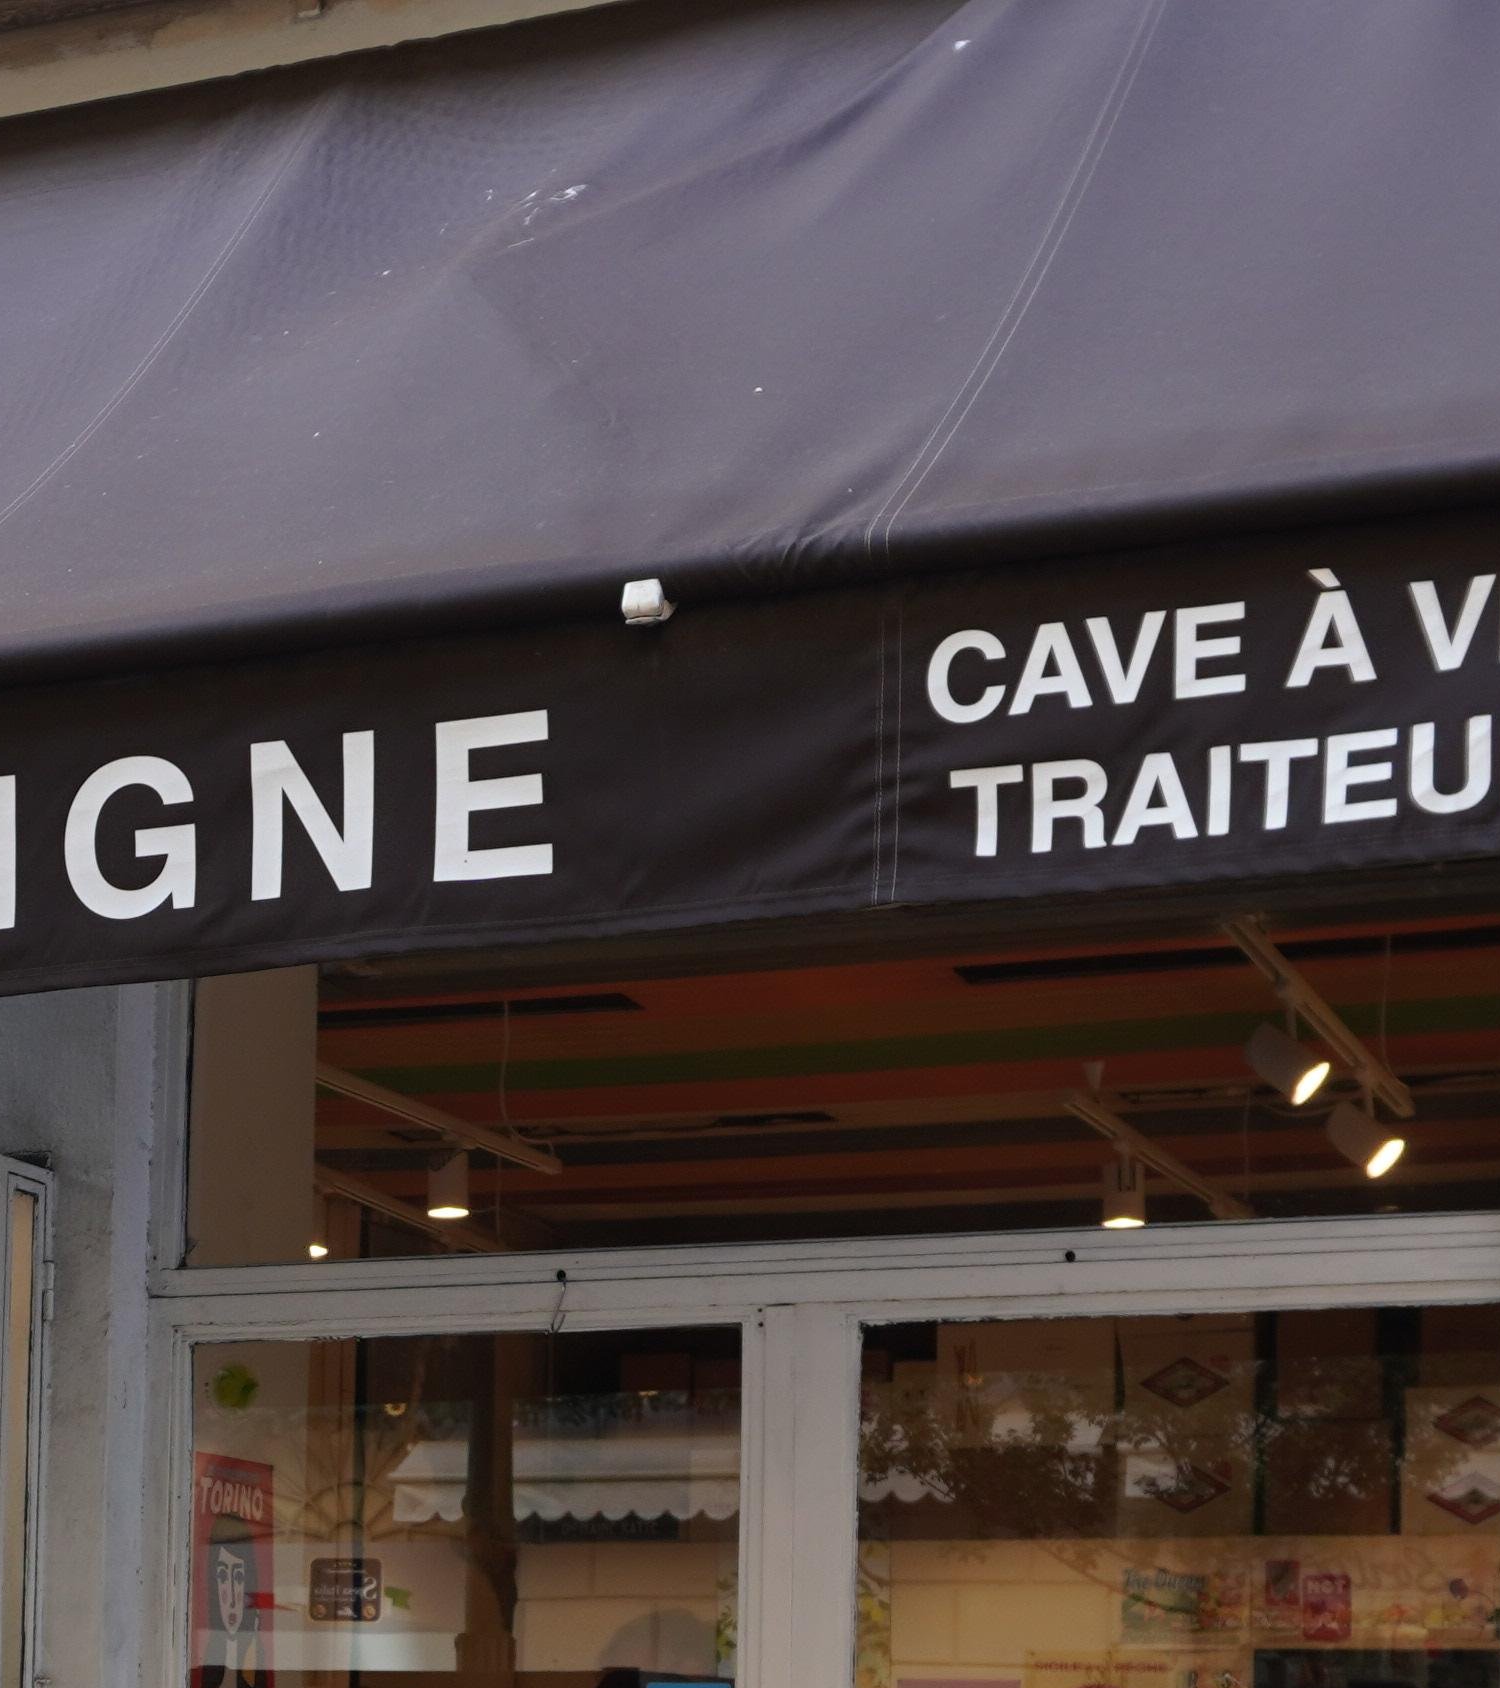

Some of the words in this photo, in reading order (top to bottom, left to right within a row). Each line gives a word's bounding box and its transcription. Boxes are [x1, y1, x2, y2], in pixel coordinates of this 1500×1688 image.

[926, 600, 1246, 725] CAVE
[1286, 568, 1377, 690] À
[200, 1476, 264, 1521] TORINO
